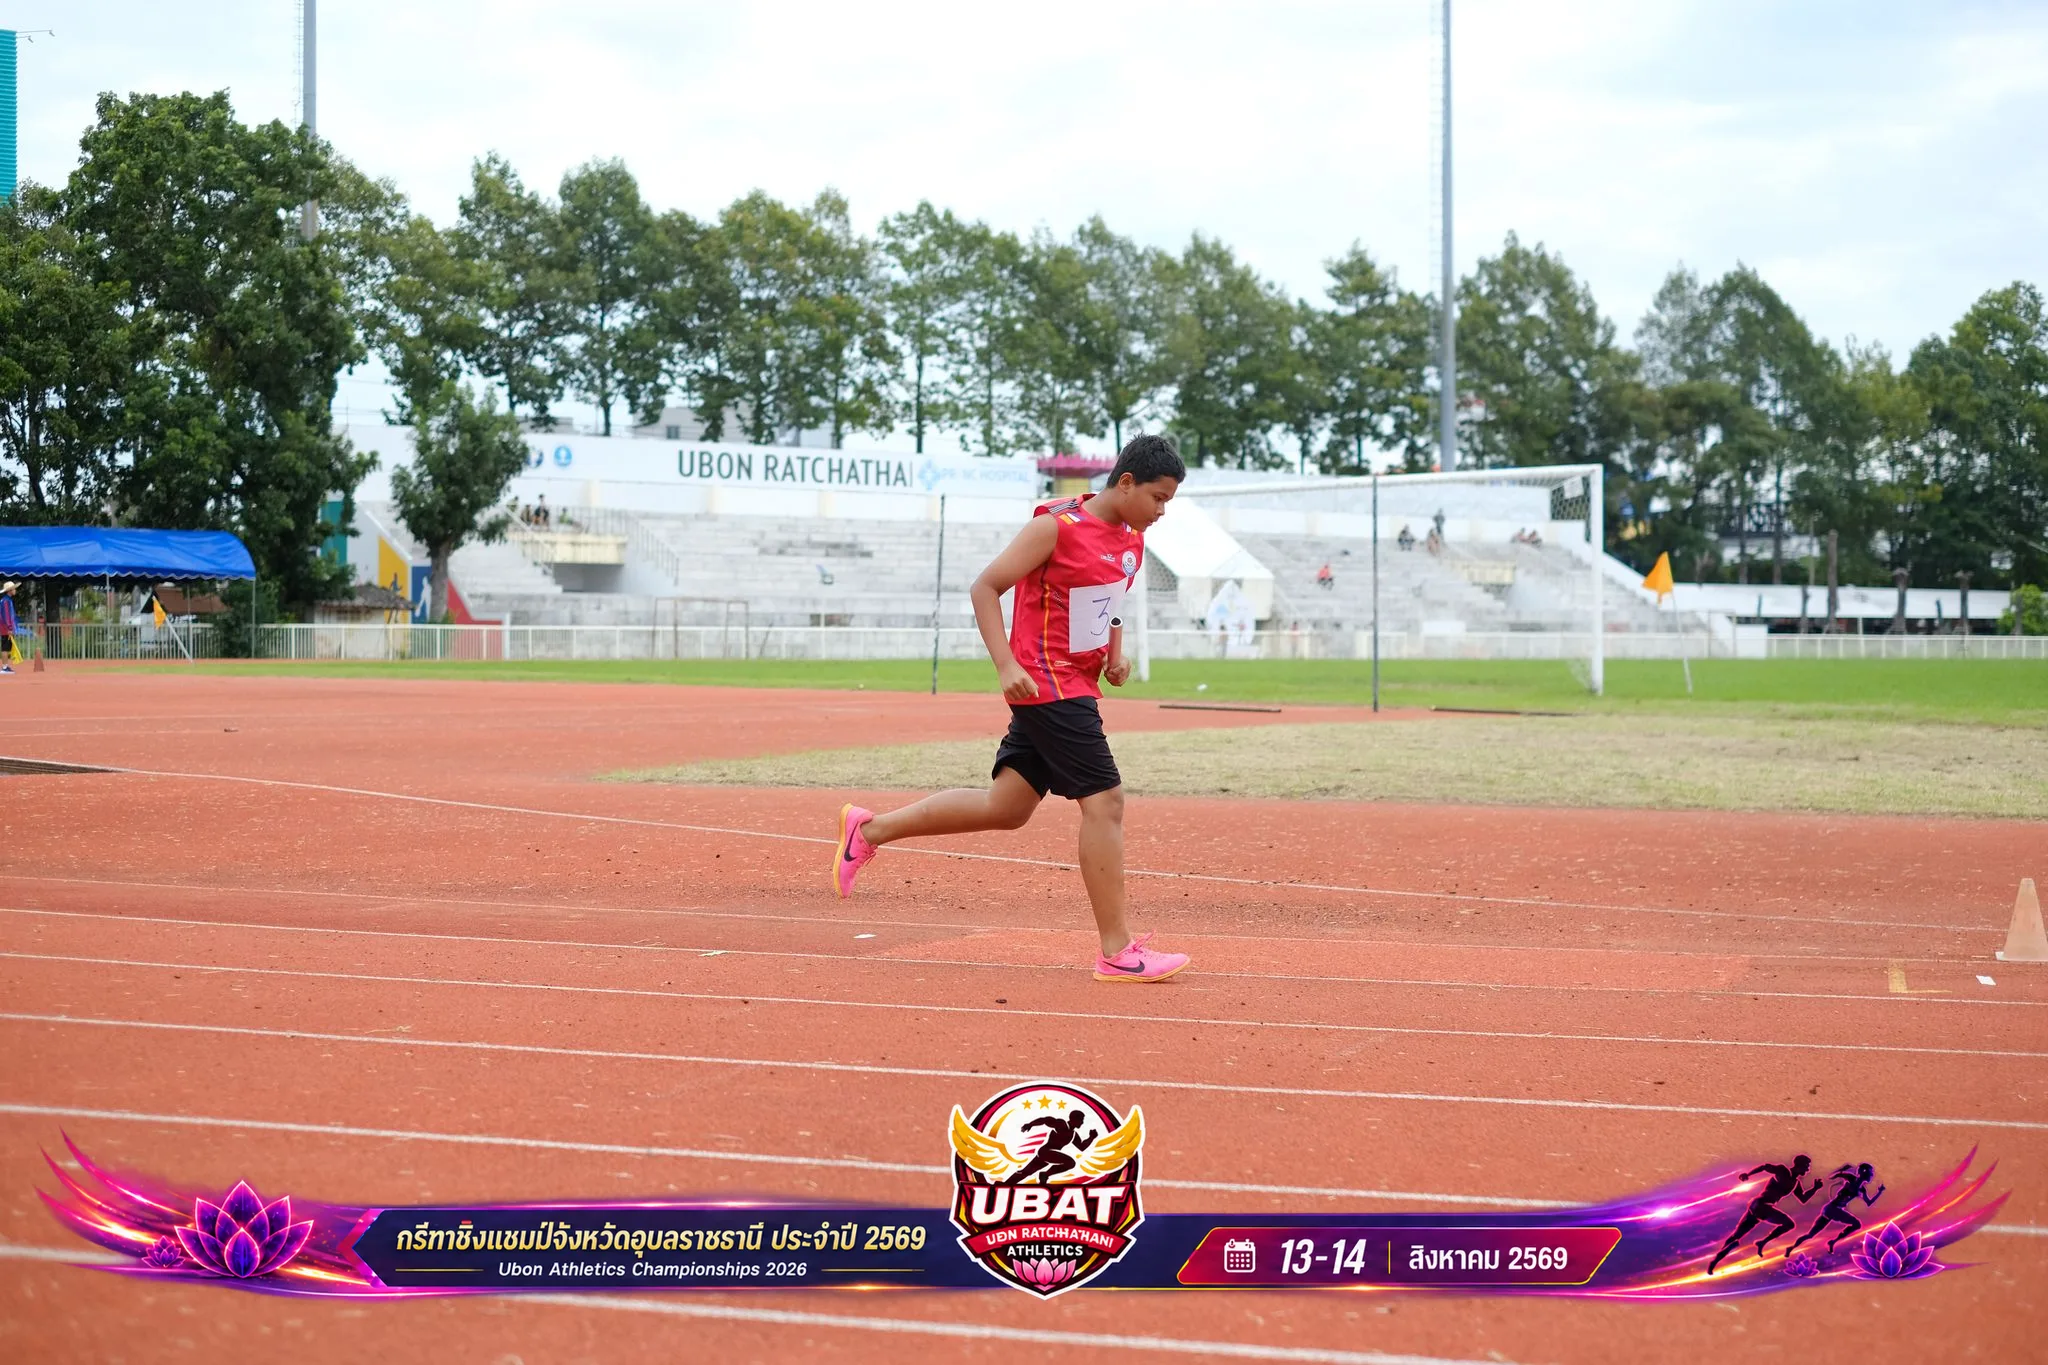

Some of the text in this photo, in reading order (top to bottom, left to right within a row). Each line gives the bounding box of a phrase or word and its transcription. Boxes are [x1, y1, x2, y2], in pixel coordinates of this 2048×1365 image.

[678, 450, 913, 488] UBON RATCHATHA
[1090, 596, 1111, 636] 3
